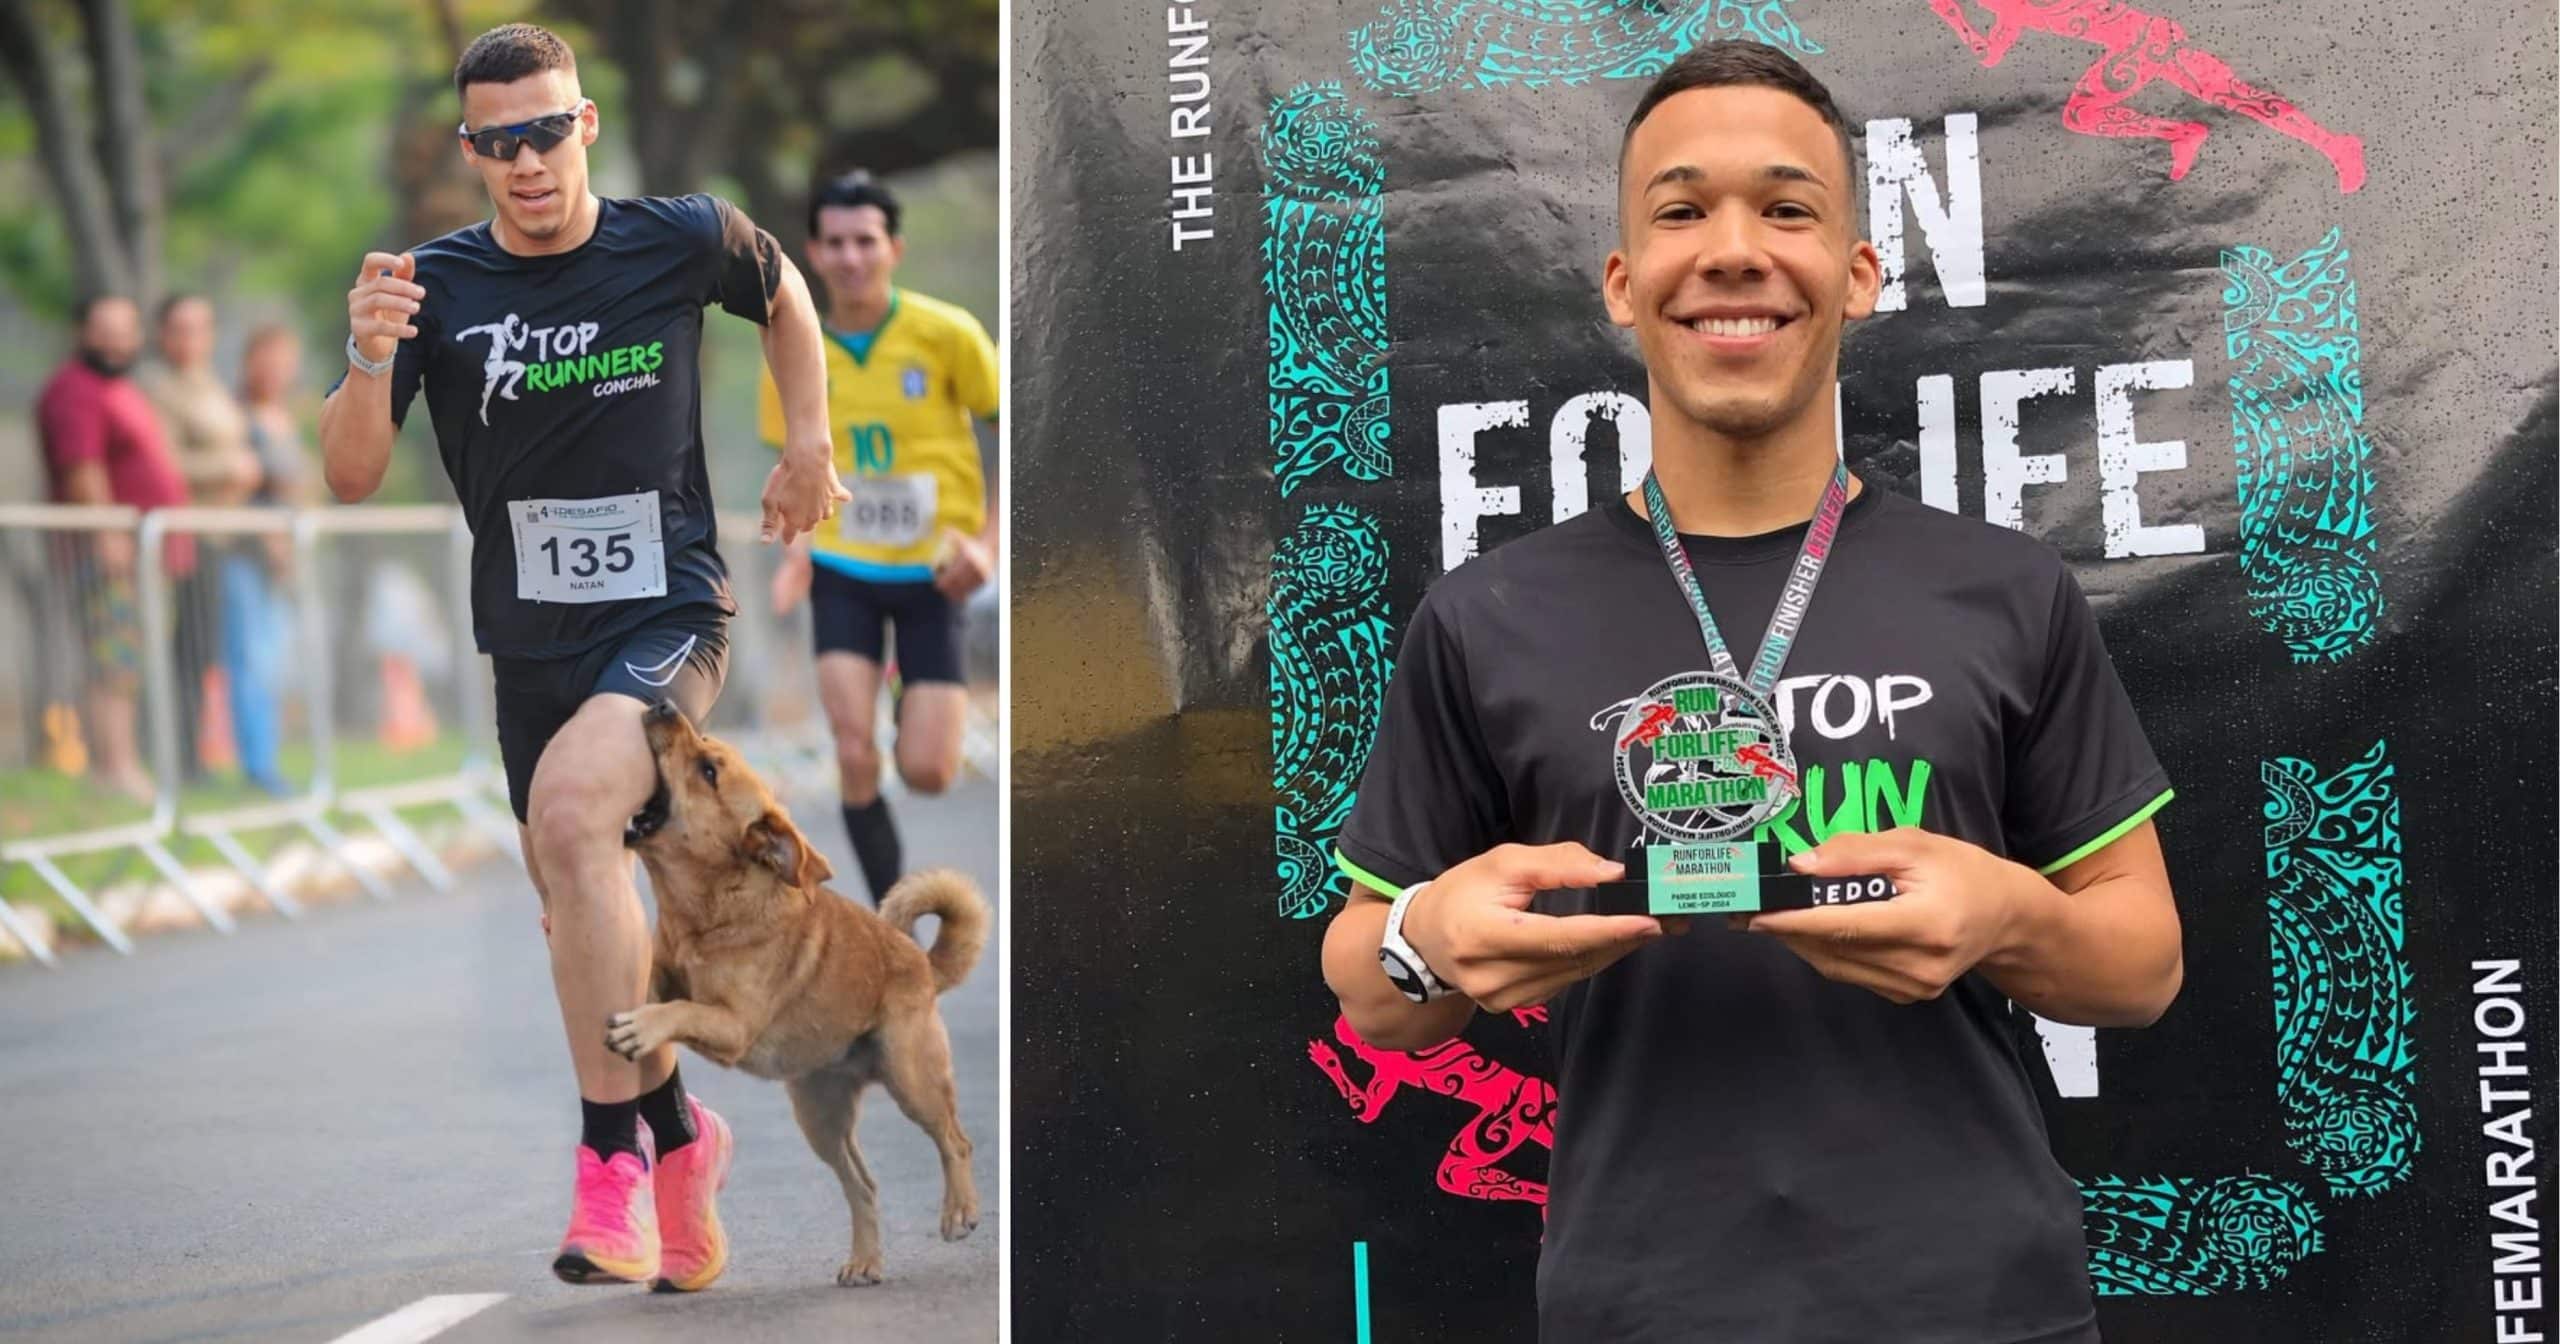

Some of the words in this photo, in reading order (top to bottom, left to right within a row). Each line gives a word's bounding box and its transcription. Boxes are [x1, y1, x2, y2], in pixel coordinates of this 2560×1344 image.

[1167, 0, 1212, 138] RUNF
[1171, 152, 1214, 251] THE
[530, 321, 599, 363] TOP
[526, 341, 664, 393] RUNNERS
[592, 372, 661, 398] CONCHAL
[849, 422, 894, 475] 10
[540, 532, 635, 578] 135
[569, 580, 606, 591] NATAN
[1674, 687, 1719, 714] RUN
[1706, 676, 1756, 701] MARATHON
[1774, 674, 1934, 742] TOP
[1653, 730, 1740, 760] FORLIFE
[1646, 776, 1768, 809] MARATHON
[1673, 846, 1733, 862] RUNFORLIFE
[1675, 861, 1731, 875] MARATHON
[2471, 959, 2544, 1344] FEMARATHON
